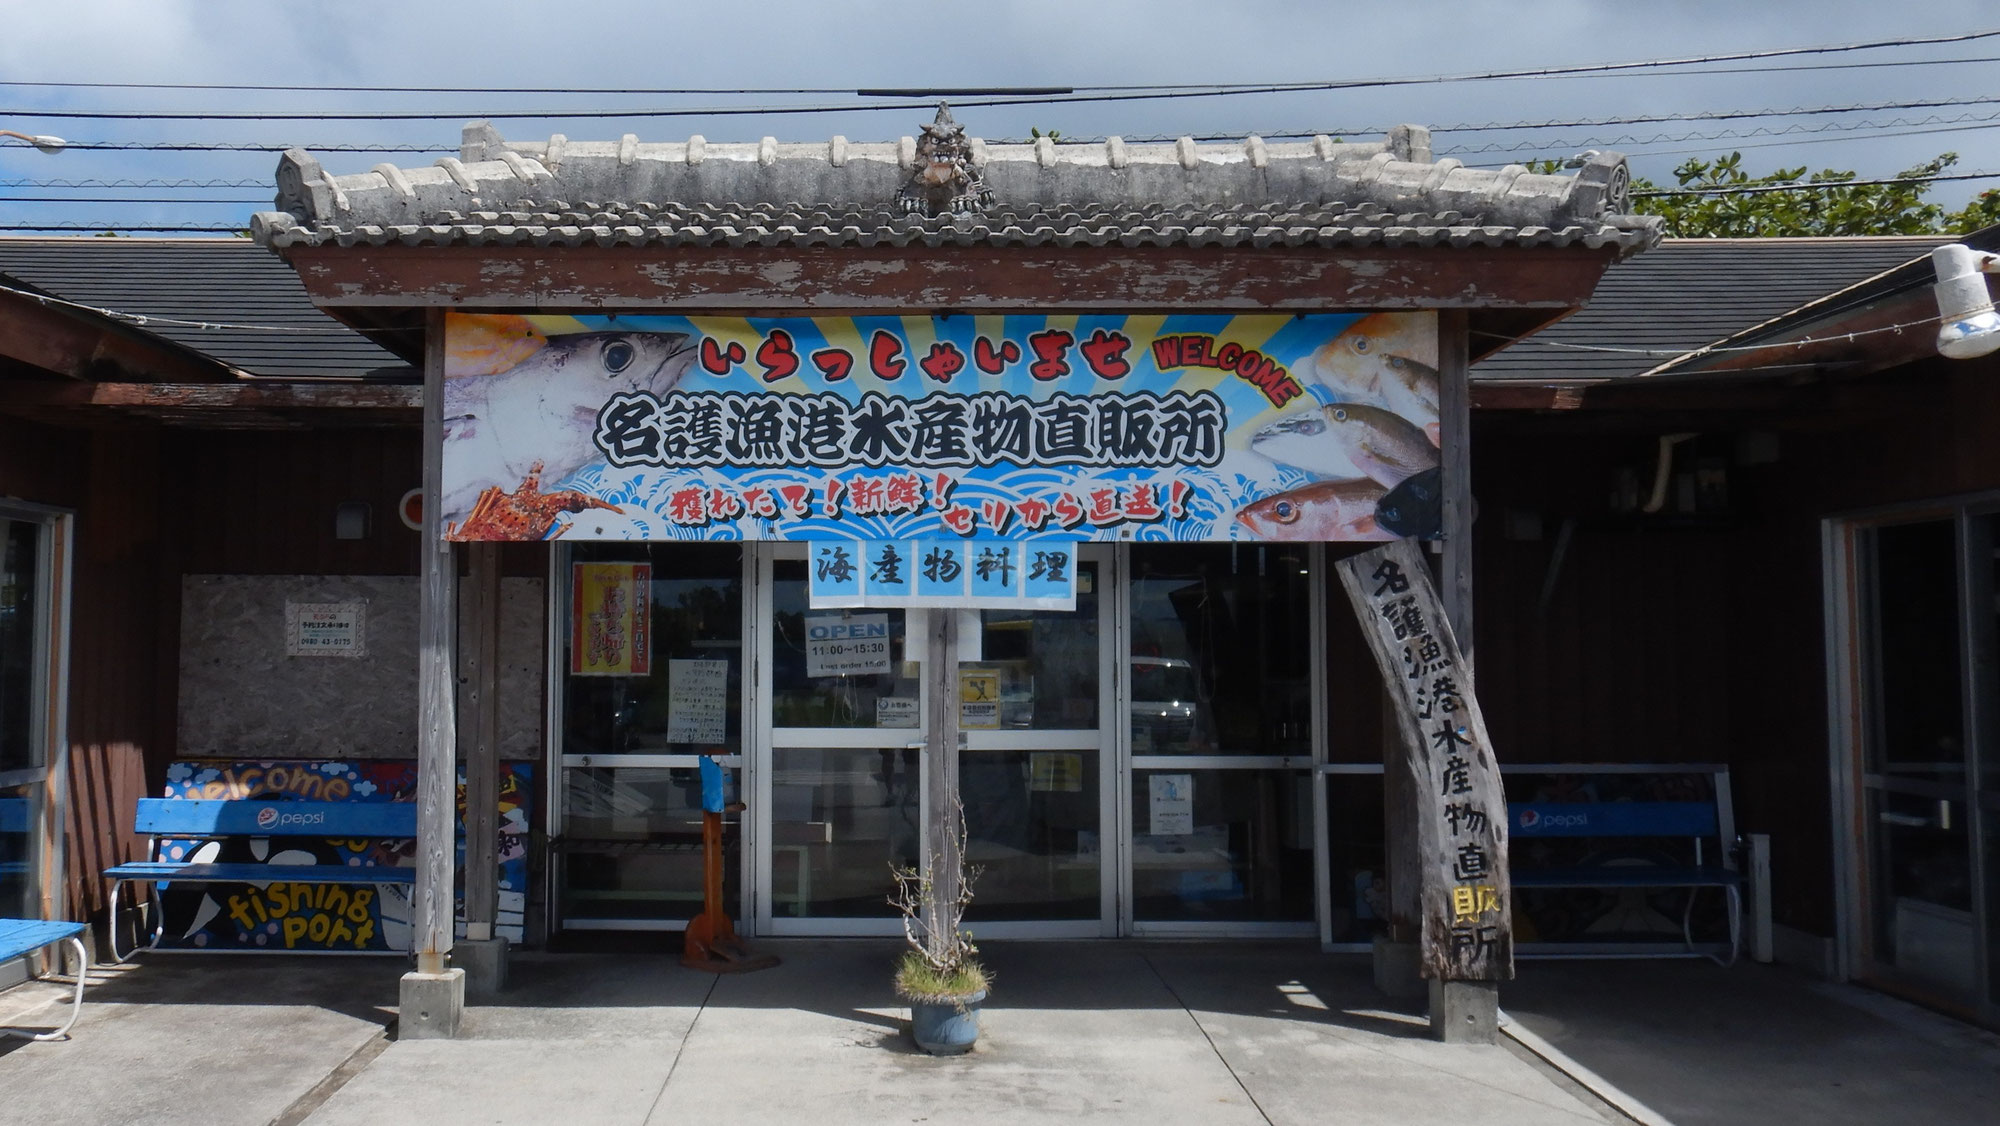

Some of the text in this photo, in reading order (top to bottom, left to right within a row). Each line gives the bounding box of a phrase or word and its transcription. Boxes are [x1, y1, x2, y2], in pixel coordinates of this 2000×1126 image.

[702, 329, 1131, 382] いらっしゃいませ
[1154, 336, 1301, 407] WELCOME
[601, 396, 1222, 463] 名護漁港水産物直販所
[817, 544, 1070, 588] 海産物料理
[809, 623, 886, 639] OPEN
[840, 662, 862, 670] order
[1371, 559, 1501, 966] 名護漁港水産物直販所
[281, 811, 325, 826] pepsi
[1544, 812, 1589, 828] pepsi
[227, 882, 375, 931] fishing
[283, 912, 375, 949] port
